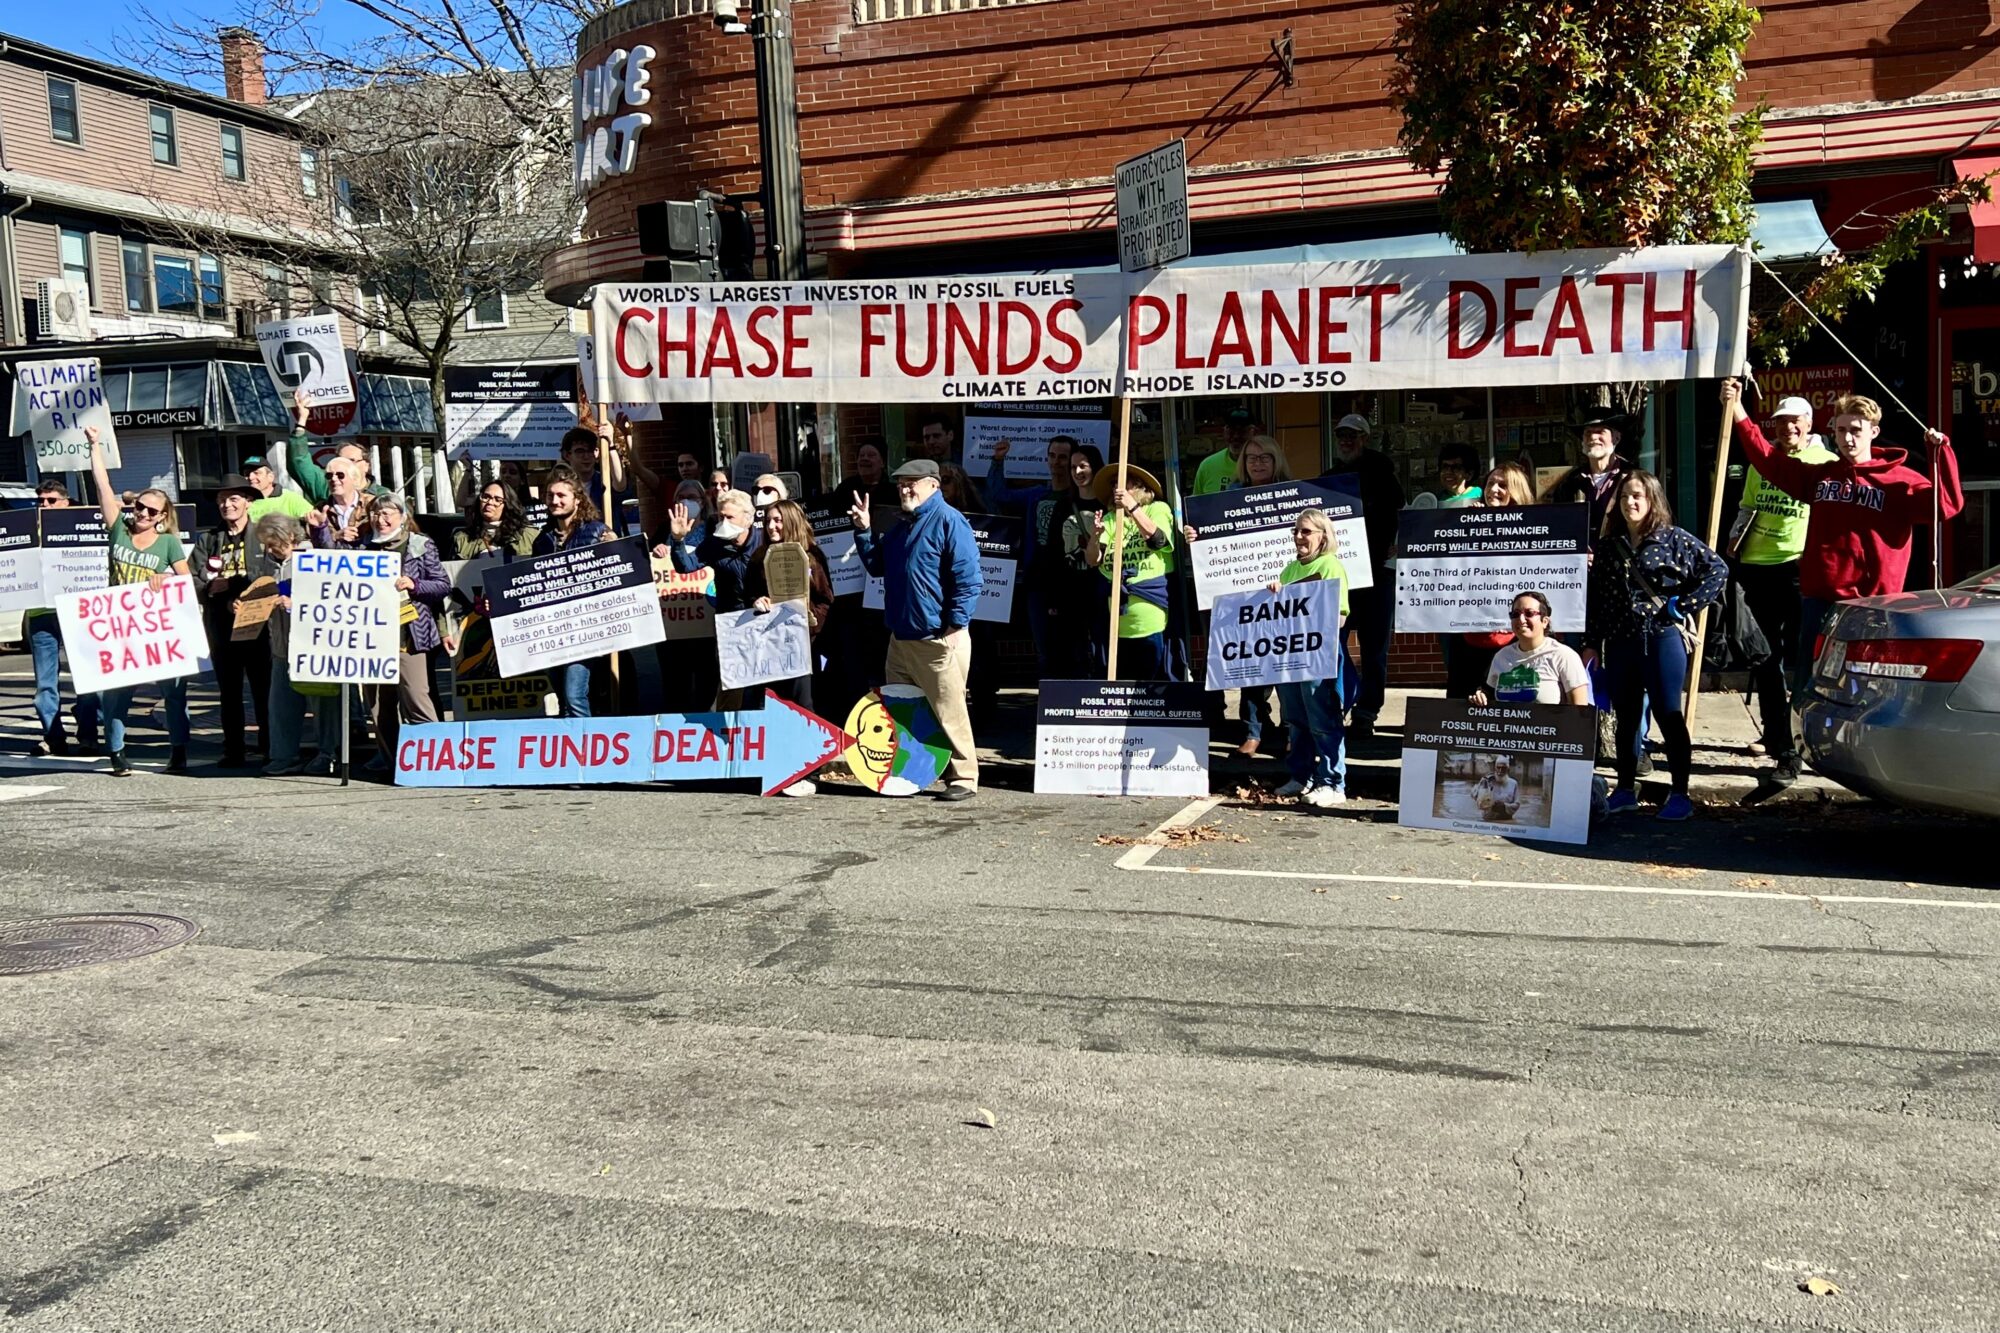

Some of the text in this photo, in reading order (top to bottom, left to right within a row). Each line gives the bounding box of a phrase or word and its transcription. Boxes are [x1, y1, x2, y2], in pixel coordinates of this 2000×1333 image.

[1118, 149, 1182, 189] MOTORCYCLES
[1137, 178, 1166, 210] WITH
[1120, 198, 1184, 234] STRAIGHT PIPES
[1124, 219, 1184, 256] PROHIBITED
[618, 280, 1075, 303] WORLD'S LARGEST INVESTOR IN FOSSIL FUELS
[257, 324, 336, 341] CLIMATE CHASE
[615, 269, 1697, 379] CHASE FUNDS PLANET DEATH
[20, 364, 97, 387] CLIMATE
[1758, 368, 1849, 393] NOW WALK-IN
[308, 385, 350, 398] HOMES
[942, 381, 1026, 397] CLIMATE
[1036, 378, 1112, 396] ACTION
[1123, 375, 1194, 393] RHODE
[29, 387, 102, 410] ACTION
[52, 412, 82, 430] R.I.
[136, 411, 196, 425] CHICKEN
[1001, 425, 1028, 433] drought
[1244, 488, 1299, 503] CHASE BANK
[1815, 480, 1886, 512] BROWN
[1224, 497, 1323, 518] FOSSIL FUEL FINANCIER
[814, 517, 851, 529] SUFFERS
[1199, 516, 1279, 535] PROFITS WHILE THE
[1460, 513, 1523, 523] CHASE BANK
[1434, 526, 1549, 538] FOSSIL FUEL FINANCIER
[1230, 535, 1295, 552] Million people
[1407, 540, 1577, 552] PROFITS WHILE PAKISTAN SUFFERS
[61, 550, 98, 558] Montana
[534, 550, 595, 570] CHASE BANK
[1209, 550, 1273, 567] displaced per
[298, 554, 398, 578] CHASE:
[512, 554, 621, 586] FOSSIL FUEL FINANCIER
[1205, 560, 1285, 578] world since 2008
[1410, 566, 1579, 577] One Third of Pakistan Underwater
[320, 581, 374, 601] END
[503, 563, 634, 599] PROFITS WHILE WORLDWIDE
[1232, 578, 1255, 586] from
[1437, 580, 1582, 592] Dead, Children
[79, 582, 187, 619] BOYCOTT
[519, 576, 622, 608] TEMPERATURES SOAR
[512, 592, 637, 628] Siberia one of the coldest
[1238, 596, 1311, 625] BANK
[1409, 597, 1492, 608] 33 million people
[88, 608, 174, 641] CHASE
[299, 604, 387, 625] FOSSIL
[500, 603, 654, 648] places on Earth hits record high
[313, 628, 377, 650] FUEL
[527, 621, 632, 654] of (June 2020)
[1222, 632, 1323, 661] CLOSED
[99, 639, 185, 674] BANK
[296, 654, 398, 679] FUNDING
[456, 679, 548, 697] DEFUND
[1100, 687, 1147, 695] CHASE BANK
[467, 693, 538, 712] LINE 3
[1081, 698, 1165, 707] FOSSIL FUEL FINANCIER
[1044, 708, 1075, 717] PROFITS
[1075, 708, 1099, 717] WHILE
[1099, 709, 1132, 717] CENTRAL
[1168, 710, 1202, 718] SUFFERS
[1467, 707, 1532, 719] CHASE BANK
[1441, 721, 1557, 735] FOSSIL FUEL FINANCIER
[400, 726, 765, 772] CHASE FUNDS DEATH
[1052, 735, 1144, 747] Sixth year of drought
[1414, 733, 1583, 753] PROFITS WHILE PAKISTAN SUFFERS
[1051, 749, 1150, 759] Most crops have failed
[1051, 761, 1201, 772] 3.5 million people need assistance
